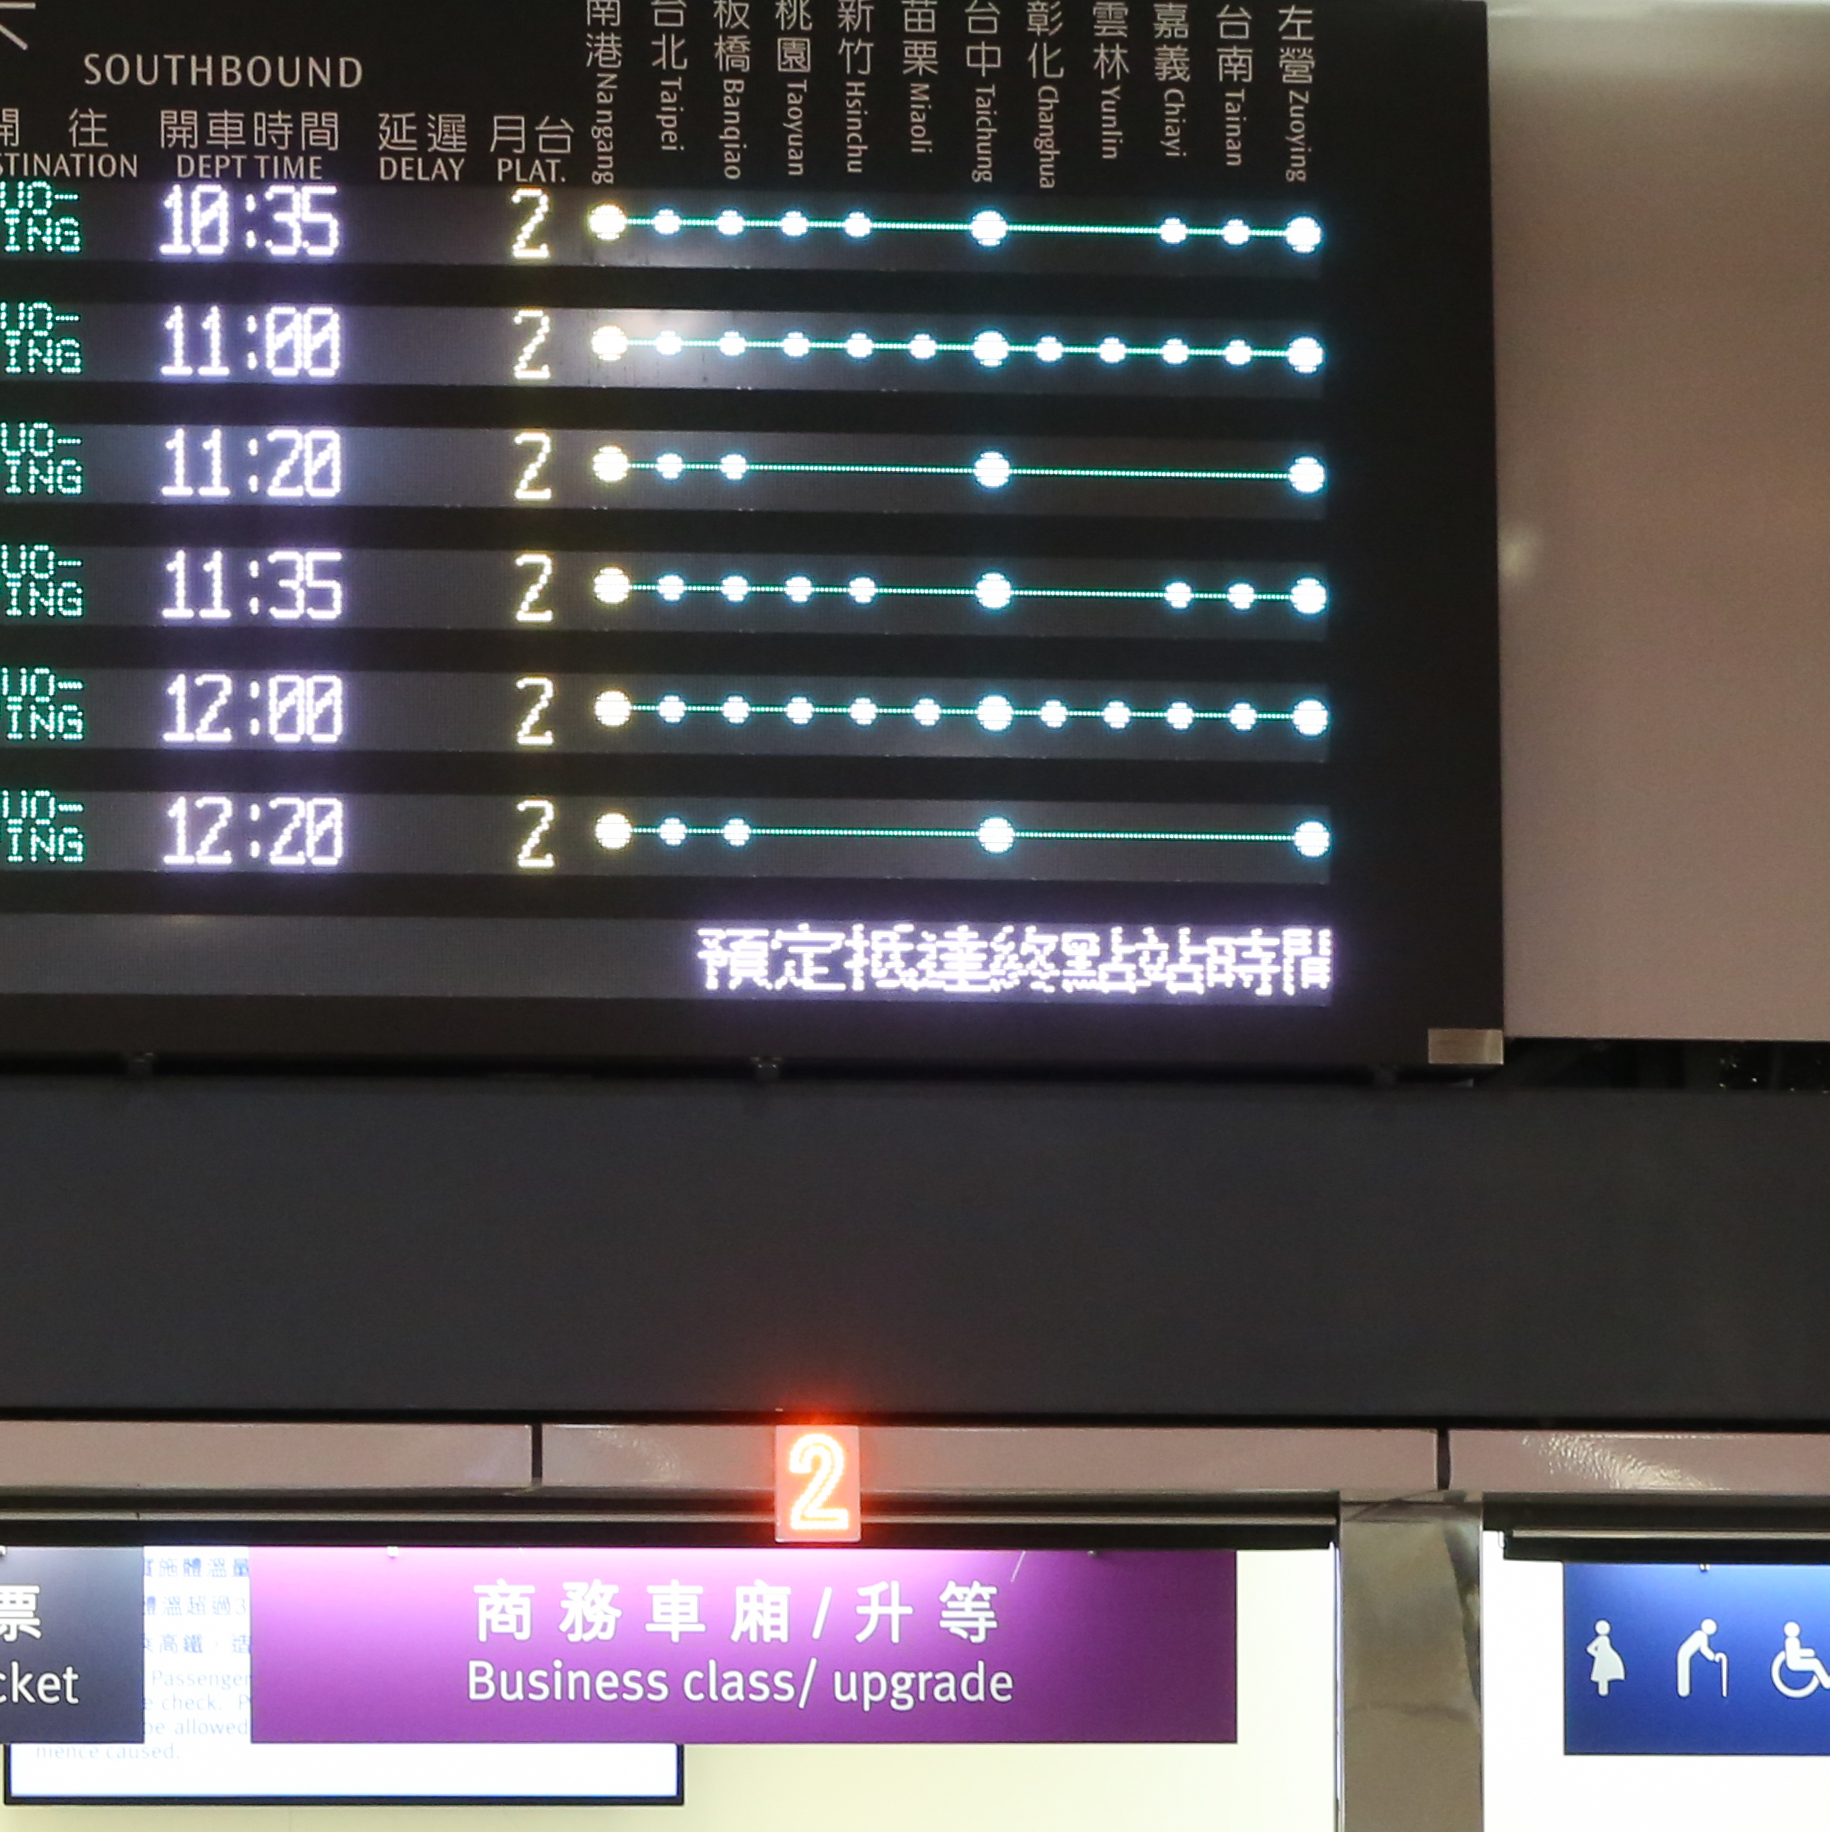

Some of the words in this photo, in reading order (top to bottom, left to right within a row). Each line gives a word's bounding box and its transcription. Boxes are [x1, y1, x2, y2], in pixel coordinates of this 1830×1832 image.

[85, 54, 362, 87] SOUTHBOUND
[161, 110, 338, 151] 開車時間
[379, 113, 467, 155] 延遲
[490, 116, 574, 156] 月台
[178, 155, 246, 180] DEPT
[254, 156, 323, 181] TIME
[380, 157, 464, 181] DELAY
[498, 158, 565, 182] PLAT.
[159, 184, 339, 258] 10:35
[511, 188, 551, 259] 2
[161, 306, 343, 376] 11:00
[162, 428, 341, 499] 11:20
[162, 550, 342, 620] 11:35
[163, 674, 343, 744] 12:00
[163, 796, 343, 866] 12:20
[787, 1432, 851, 1531] 2
[469, 1660, 667, 1700] Business
[684, 1658, 816, 1708] class/
[835, 1661, 1012, 1711] upgrade
